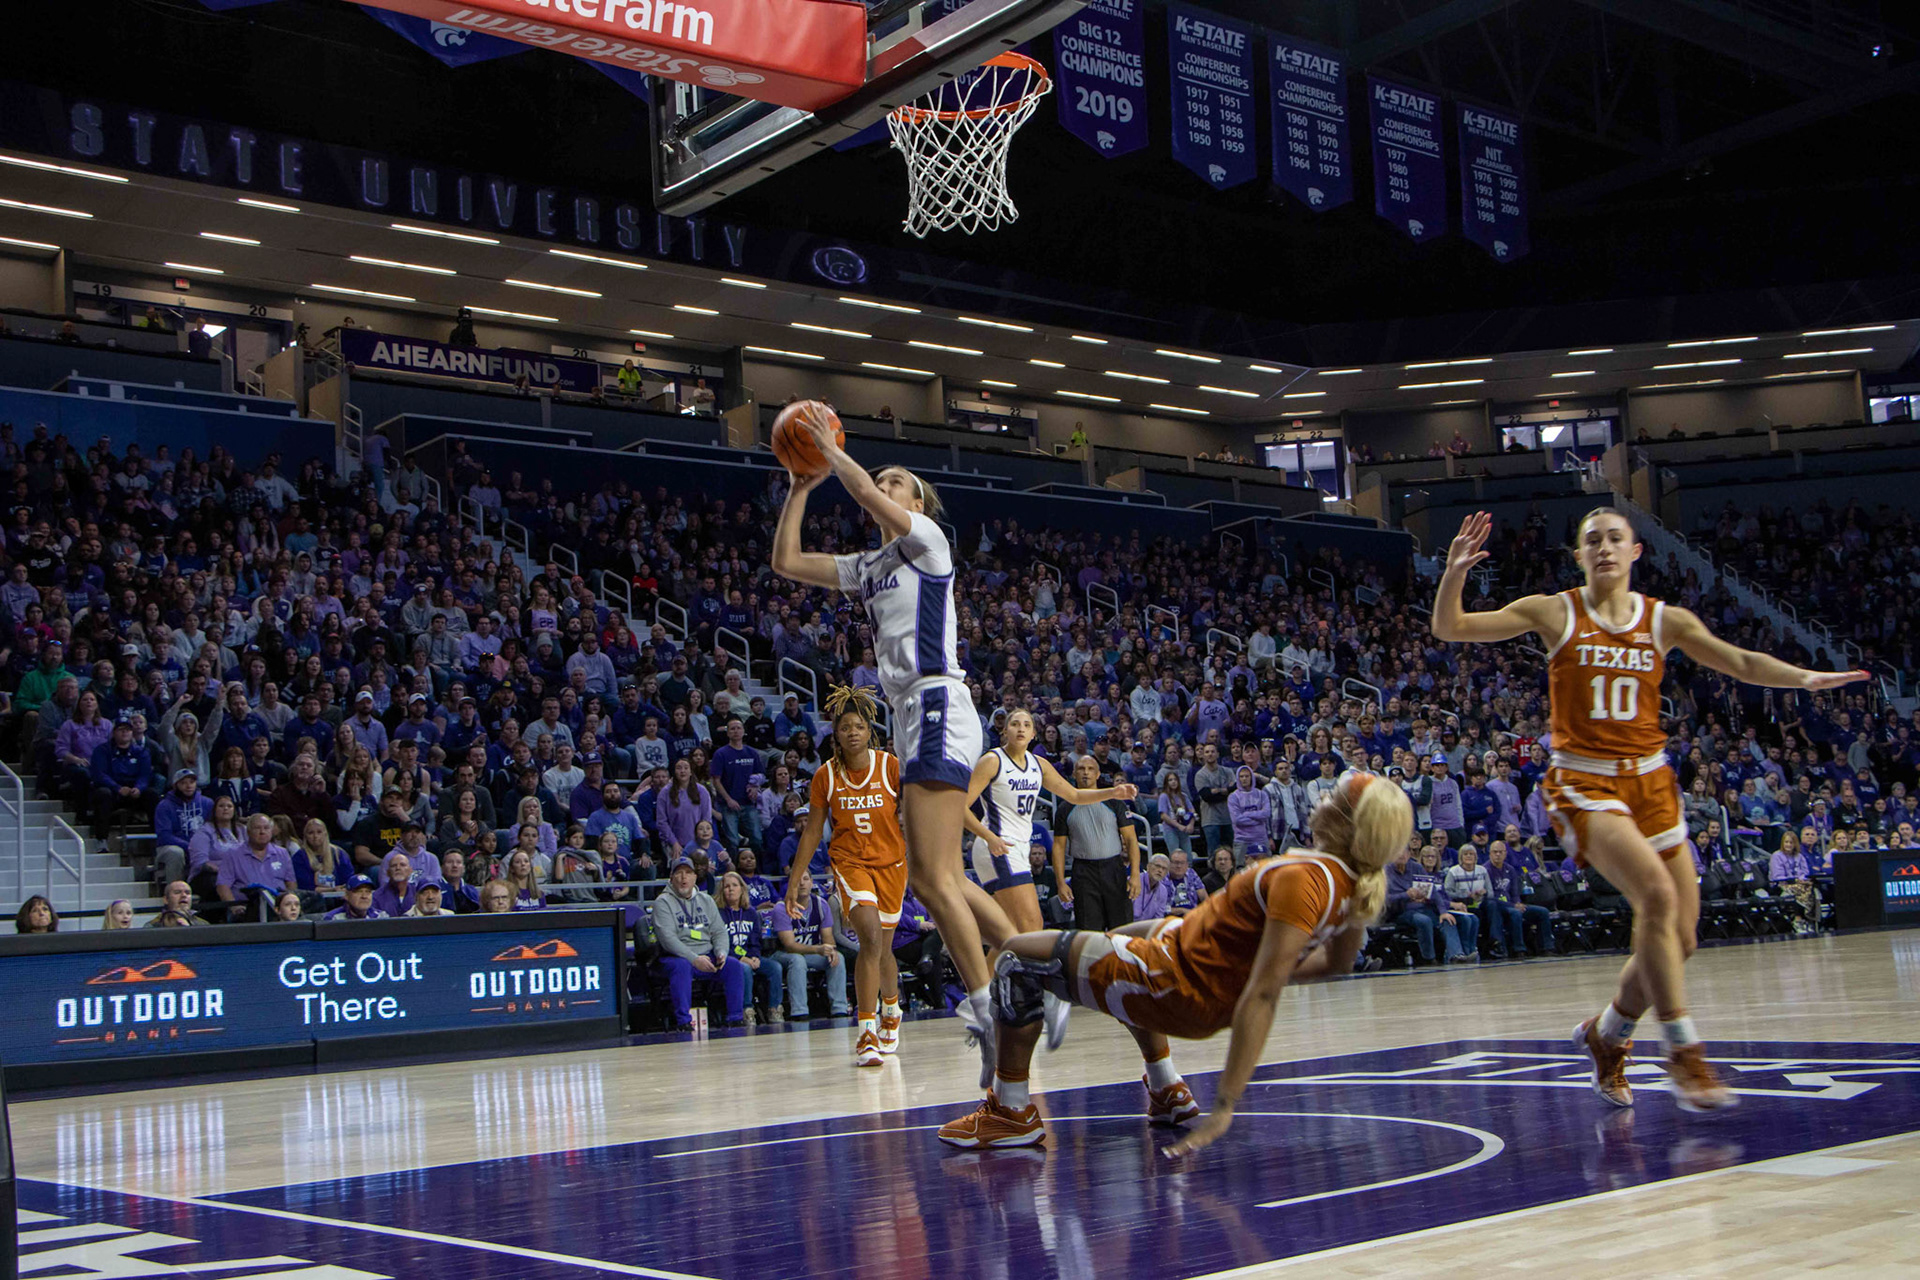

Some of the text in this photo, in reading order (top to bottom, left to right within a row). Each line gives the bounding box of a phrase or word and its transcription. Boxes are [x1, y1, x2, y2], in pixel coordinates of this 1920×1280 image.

[445, 9, 700, 75] StateFarm
[1078, 20, 1122, 46] BIG 12
[1176, 15, 1245, 49] K-STATE
[1061, 35, 1142, 68] CONFERENCE
[1202, 40, 1242, 57] BASKETBALL
[1061, 50, 1144, 87] CHAMPIONS
[1185, 52, 1241, 76] CONFERENCE
[1275, 45, 1340, 77] K-STATE
[1177, 62, 1249, 89] CHAMPIONSHIPS
[1300, 67, 1336, 84] BASKETBALL
[1186, 85, 1241, 109] 1917 1951
[1278, 89, 1344, 115] CHAMPIONSHIPS
[1285, 80, 1336, 103] CONFERENCE
[1375, 85, 1435, 115] K-STATE
[1075, 86, 1134, 123] 2019
[1187, 101, 1243, 124] 1919 1956
[1188, 116, 1244, 139] 1948 1958
[1287, 112, 1337, 134] 1960 1968
[1384, 118, 1432, 140] CONFERENCE
[1463, 110, 1518, 139] K-STATE
[1189, 131, 1245, 153] 1950 1959
[1287, 126, 1339, 149] 1961 1970
[1377, 126, 1440, 152] CHAMPIONSHIPS
[1288, 141, 1339, 163] 1963 1972
[1386, 148, 1406, 162] 1977
[1485, 146, 1502, 162] NIT
[1289, 155, 1341, 177] 1964 1973
[1387, 161, 1409, 176] 1980
[71, 103, 747, 267] STATE UNIVERSITY
[1389, 176, 1410, 190] 2013
[1390, 189, 1411, 203] 2019
[92, 284, 112, 297] 19
[249, 304, 267, 317] 20
[371, 341, 561, 385] AHEARNFUND
[573, 348, 588, 359] 20
[1009, 407, 1021, 416] 22
[1272, 433, 1285, 441] 22
[1310, 430, 1323, 439] 22
[728, 614, 746, 623] STATE
[1575, 644, 1655, 672] TEXAS
[1589, 675, 1640, 721] 10
[1203, 705, 1224, 716] Cats
[1520, 744, 1531, 757] 15
[1008, 778, 1039, 791] Wildcats
[838, 794, 884, 810] TEXAS
[1017, 794, 1035, 816] 50
[1440, 793, 1453, 805] 22
[854, 812, 873, 834] 5
[279, 951, 423, 988] Get Out
[471, 965, 600, 999] OUTDOOR
[57, 989, 224, 1028] OUTDOOR
[296, 991, 406, 1025] There.
[507, 999, 567, 1013] BANK
[105, 1026, 180, 1043] BANK
